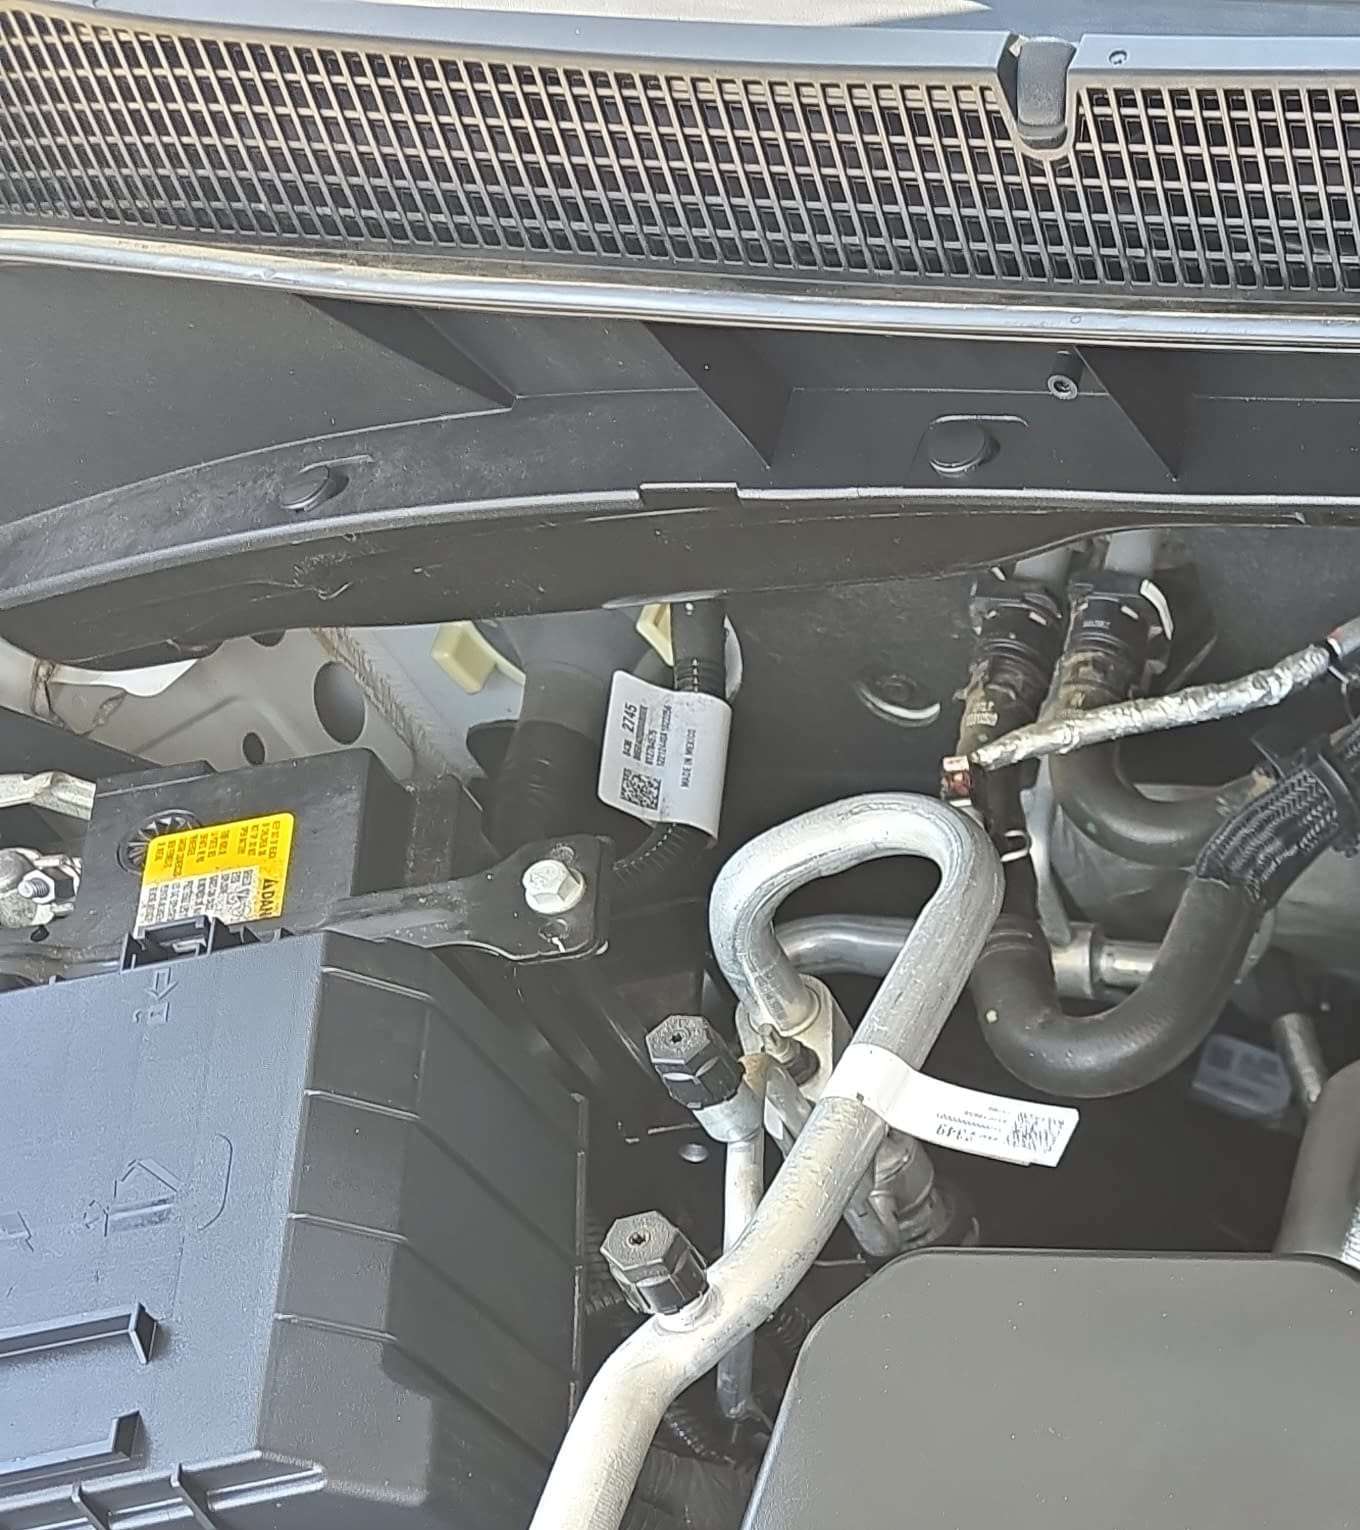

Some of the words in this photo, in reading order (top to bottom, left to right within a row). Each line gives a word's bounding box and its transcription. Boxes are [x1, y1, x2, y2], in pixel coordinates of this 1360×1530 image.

[622, 702, 638, 733] 2745
[684, 728, 697, 755] MEXICO
[682, 758, 692, 766] IN
[680, 767, 691, 788] MADE
